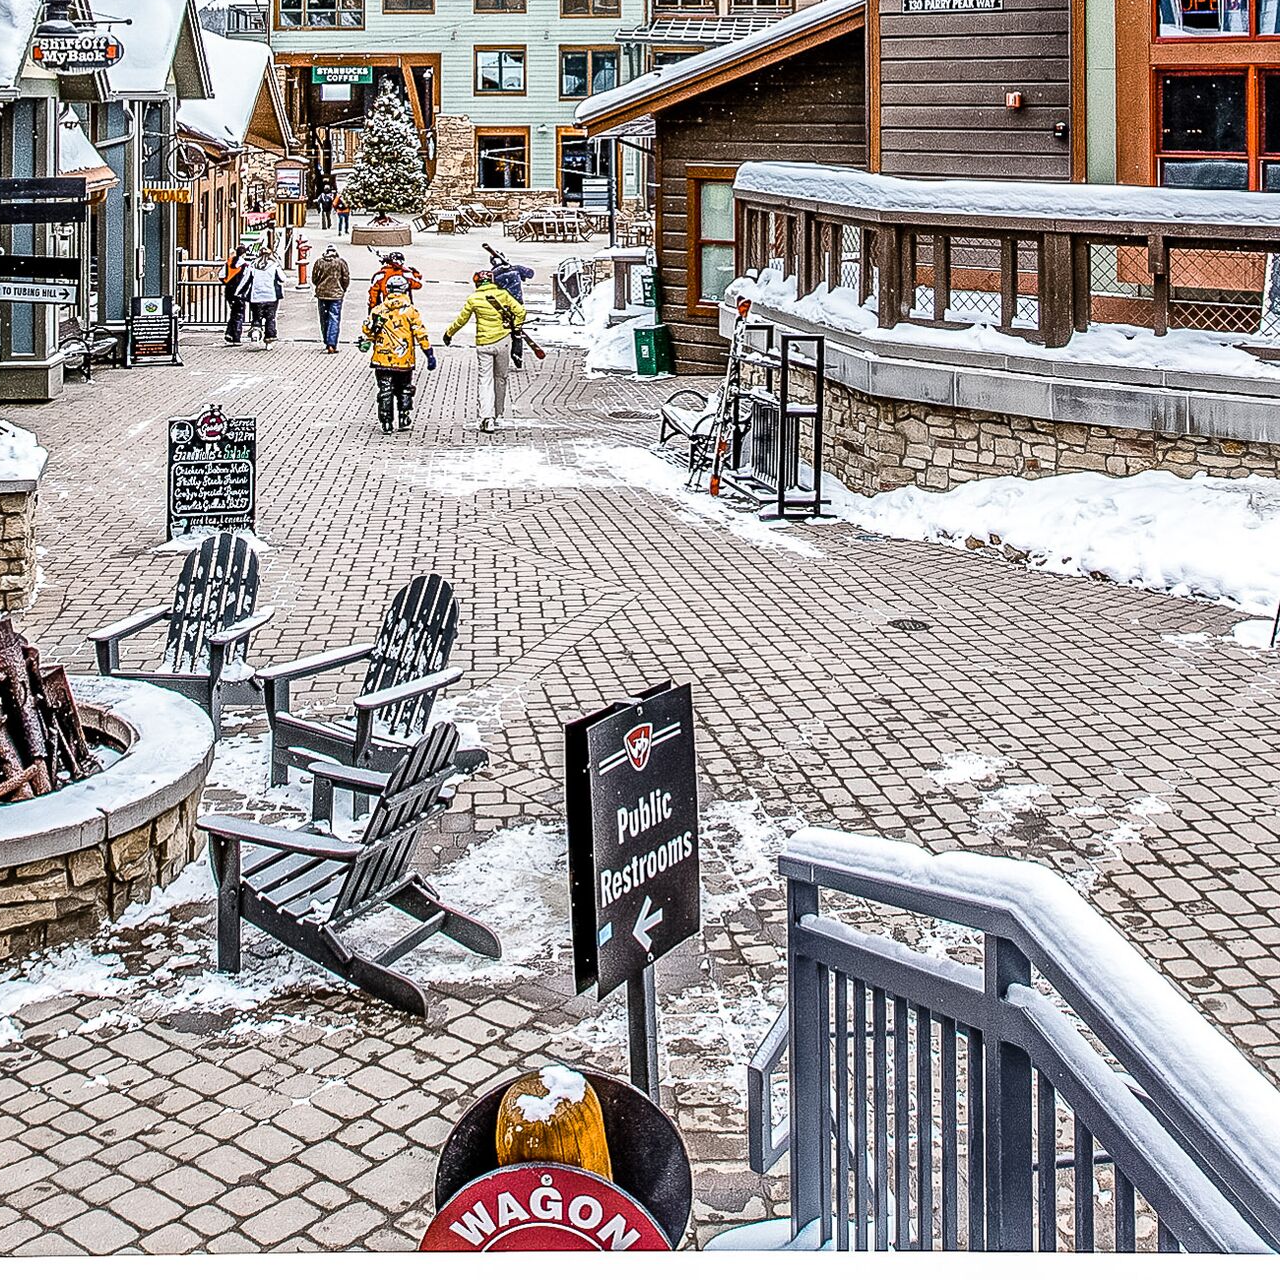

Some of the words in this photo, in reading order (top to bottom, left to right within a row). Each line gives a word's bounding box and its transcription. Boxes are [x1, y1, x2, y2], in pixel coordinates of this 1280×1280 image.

[908, 0, 923, 11] 130
[316, 67, 369, 75] STARBUCKS
[2, 286, 12, 295] TO
[13, 287, 41, 297] TUBING
[42, 288, 57, 298] HILL
[616, 788, 673, 845] Public
[600, 830, 693, 909] Restrooms
[448, 1186, 641, 1252] WAGON
